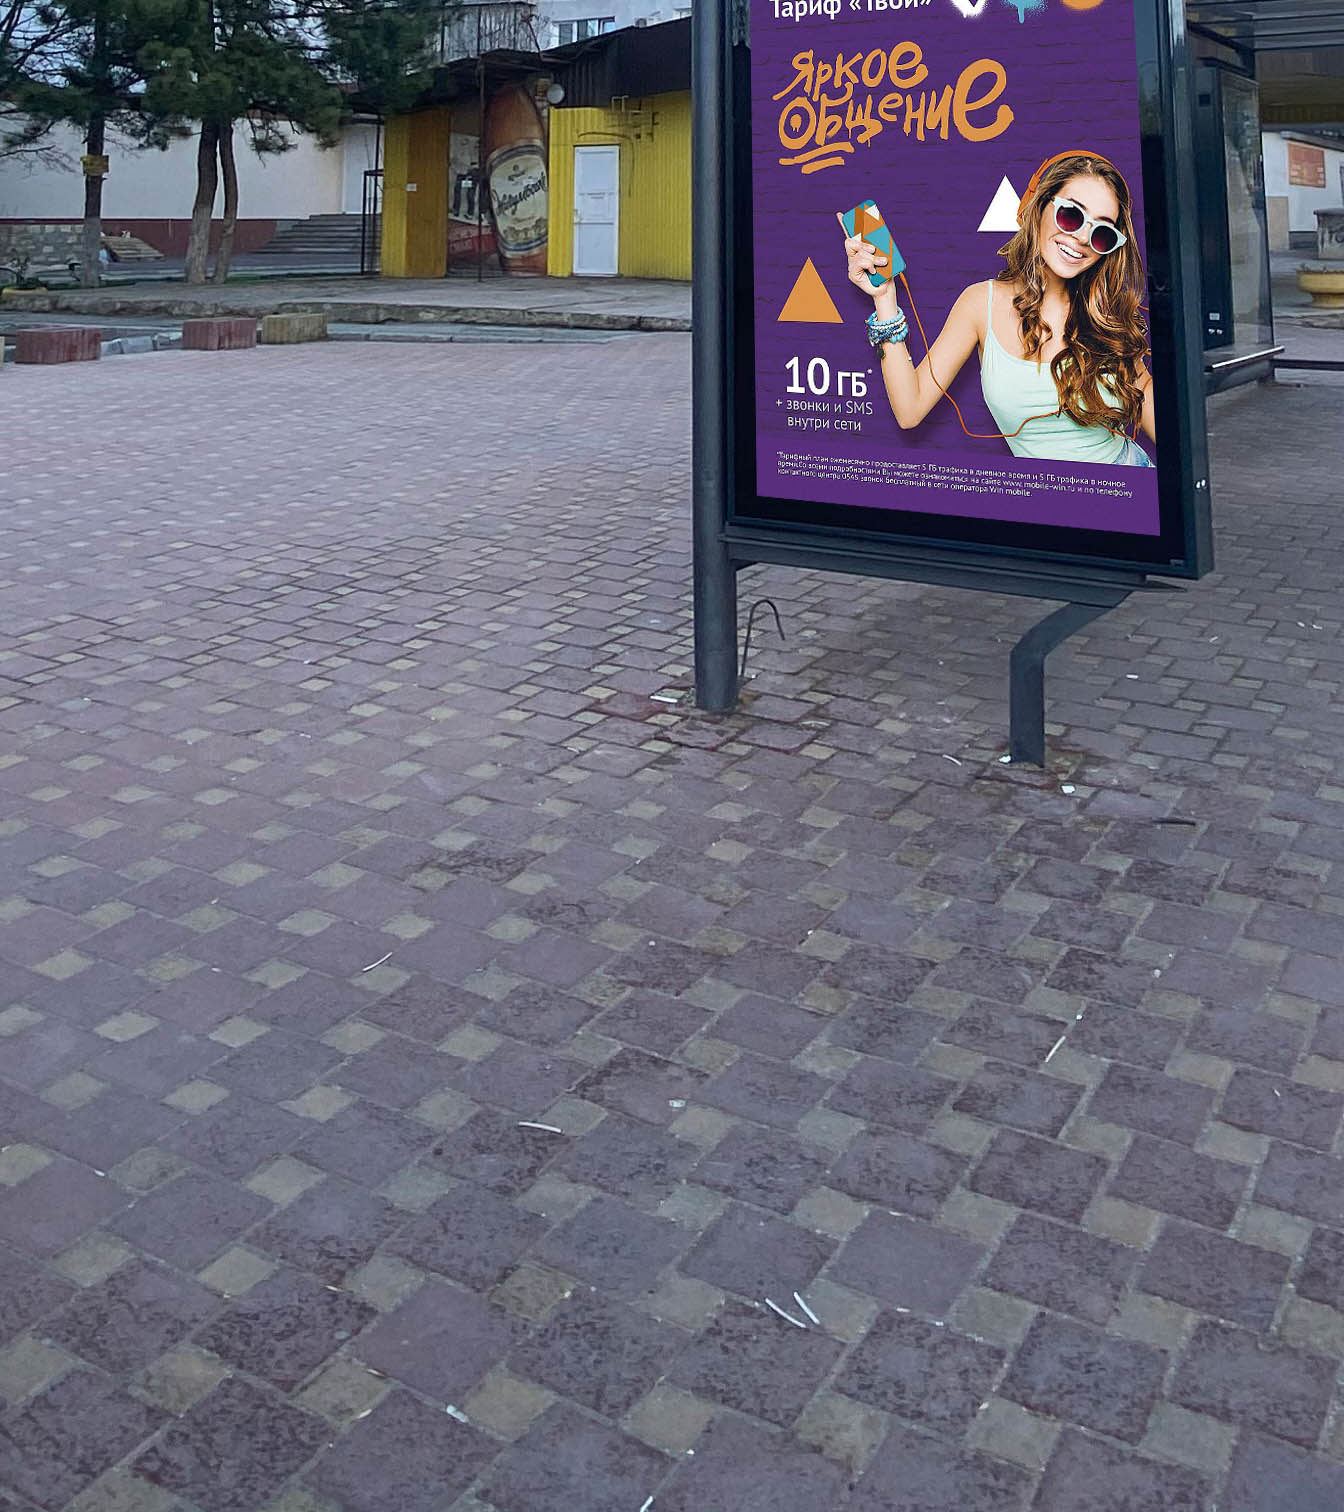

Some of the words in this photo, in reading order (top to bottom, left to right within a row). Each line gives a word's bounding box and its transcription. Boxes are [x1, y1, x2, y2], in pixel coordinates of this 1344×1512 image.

[785, 356, 830, 396] 10
[786, 400, 830, 413] звонки
[834, 403, 842, 413] и
[845, 400, 873, 415] SMS
[787, 416, 830, 431] внутри
[834, 419, 861, 431] сети
[928, 463, 937, 472] ГБ
[1046, 474, 1055, 482] ГБ
